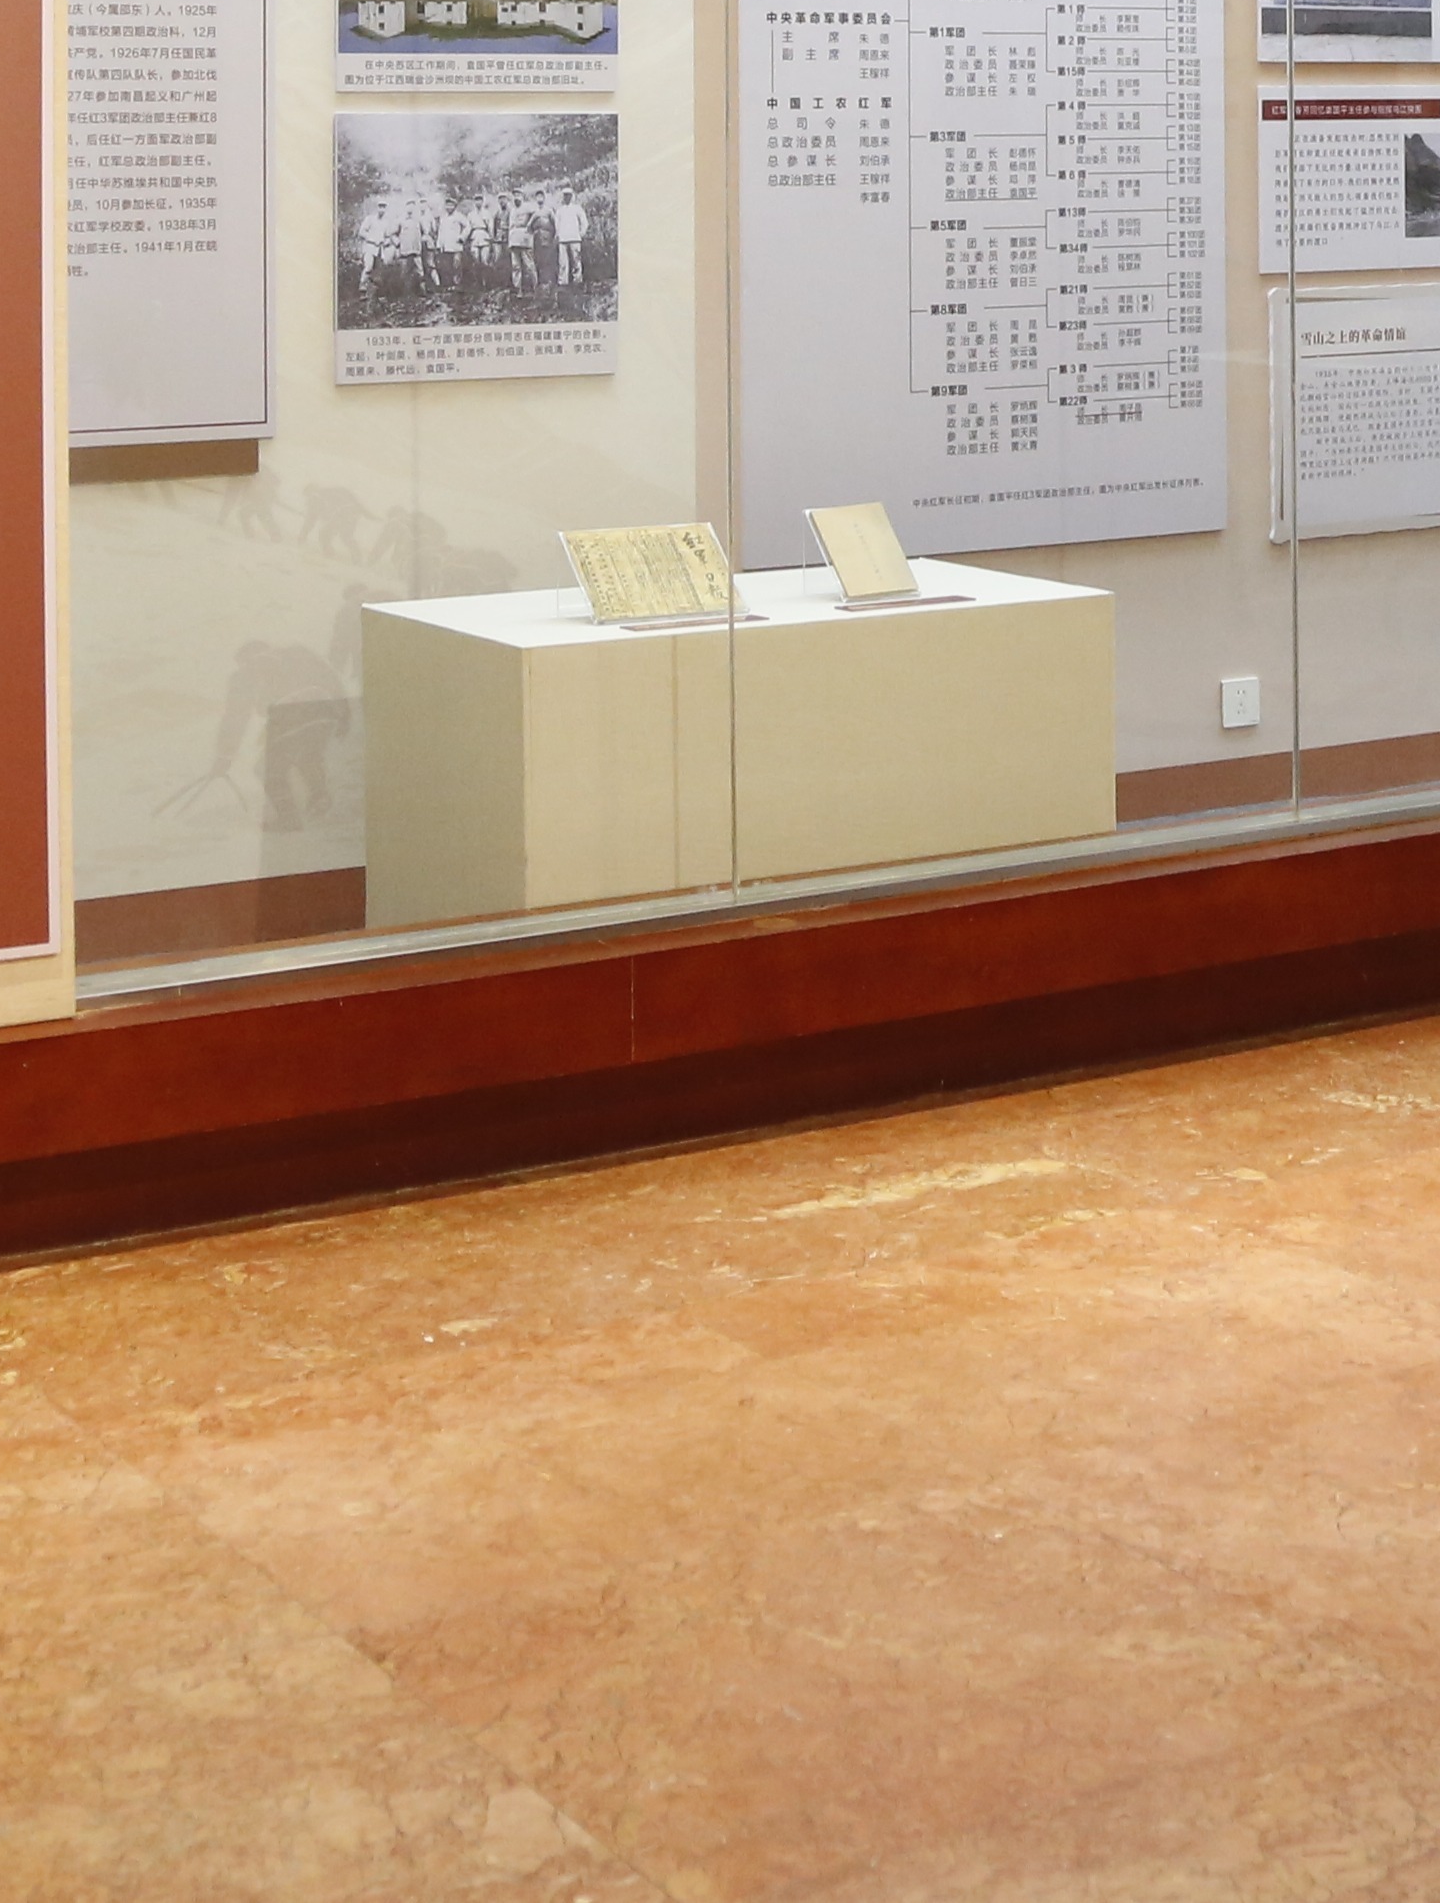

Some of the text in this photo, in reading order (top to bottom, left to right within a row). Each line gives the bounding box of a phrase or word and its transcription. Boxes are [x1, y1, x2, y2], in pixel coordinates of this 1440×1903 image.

[68, 48, 216, 59] 产党。1926年7月任国民革
[68, 69, 217, 80] 传队第四队队长，参加北伐
[68, 198, 216, 211] 员，10月参加长征。1935年
